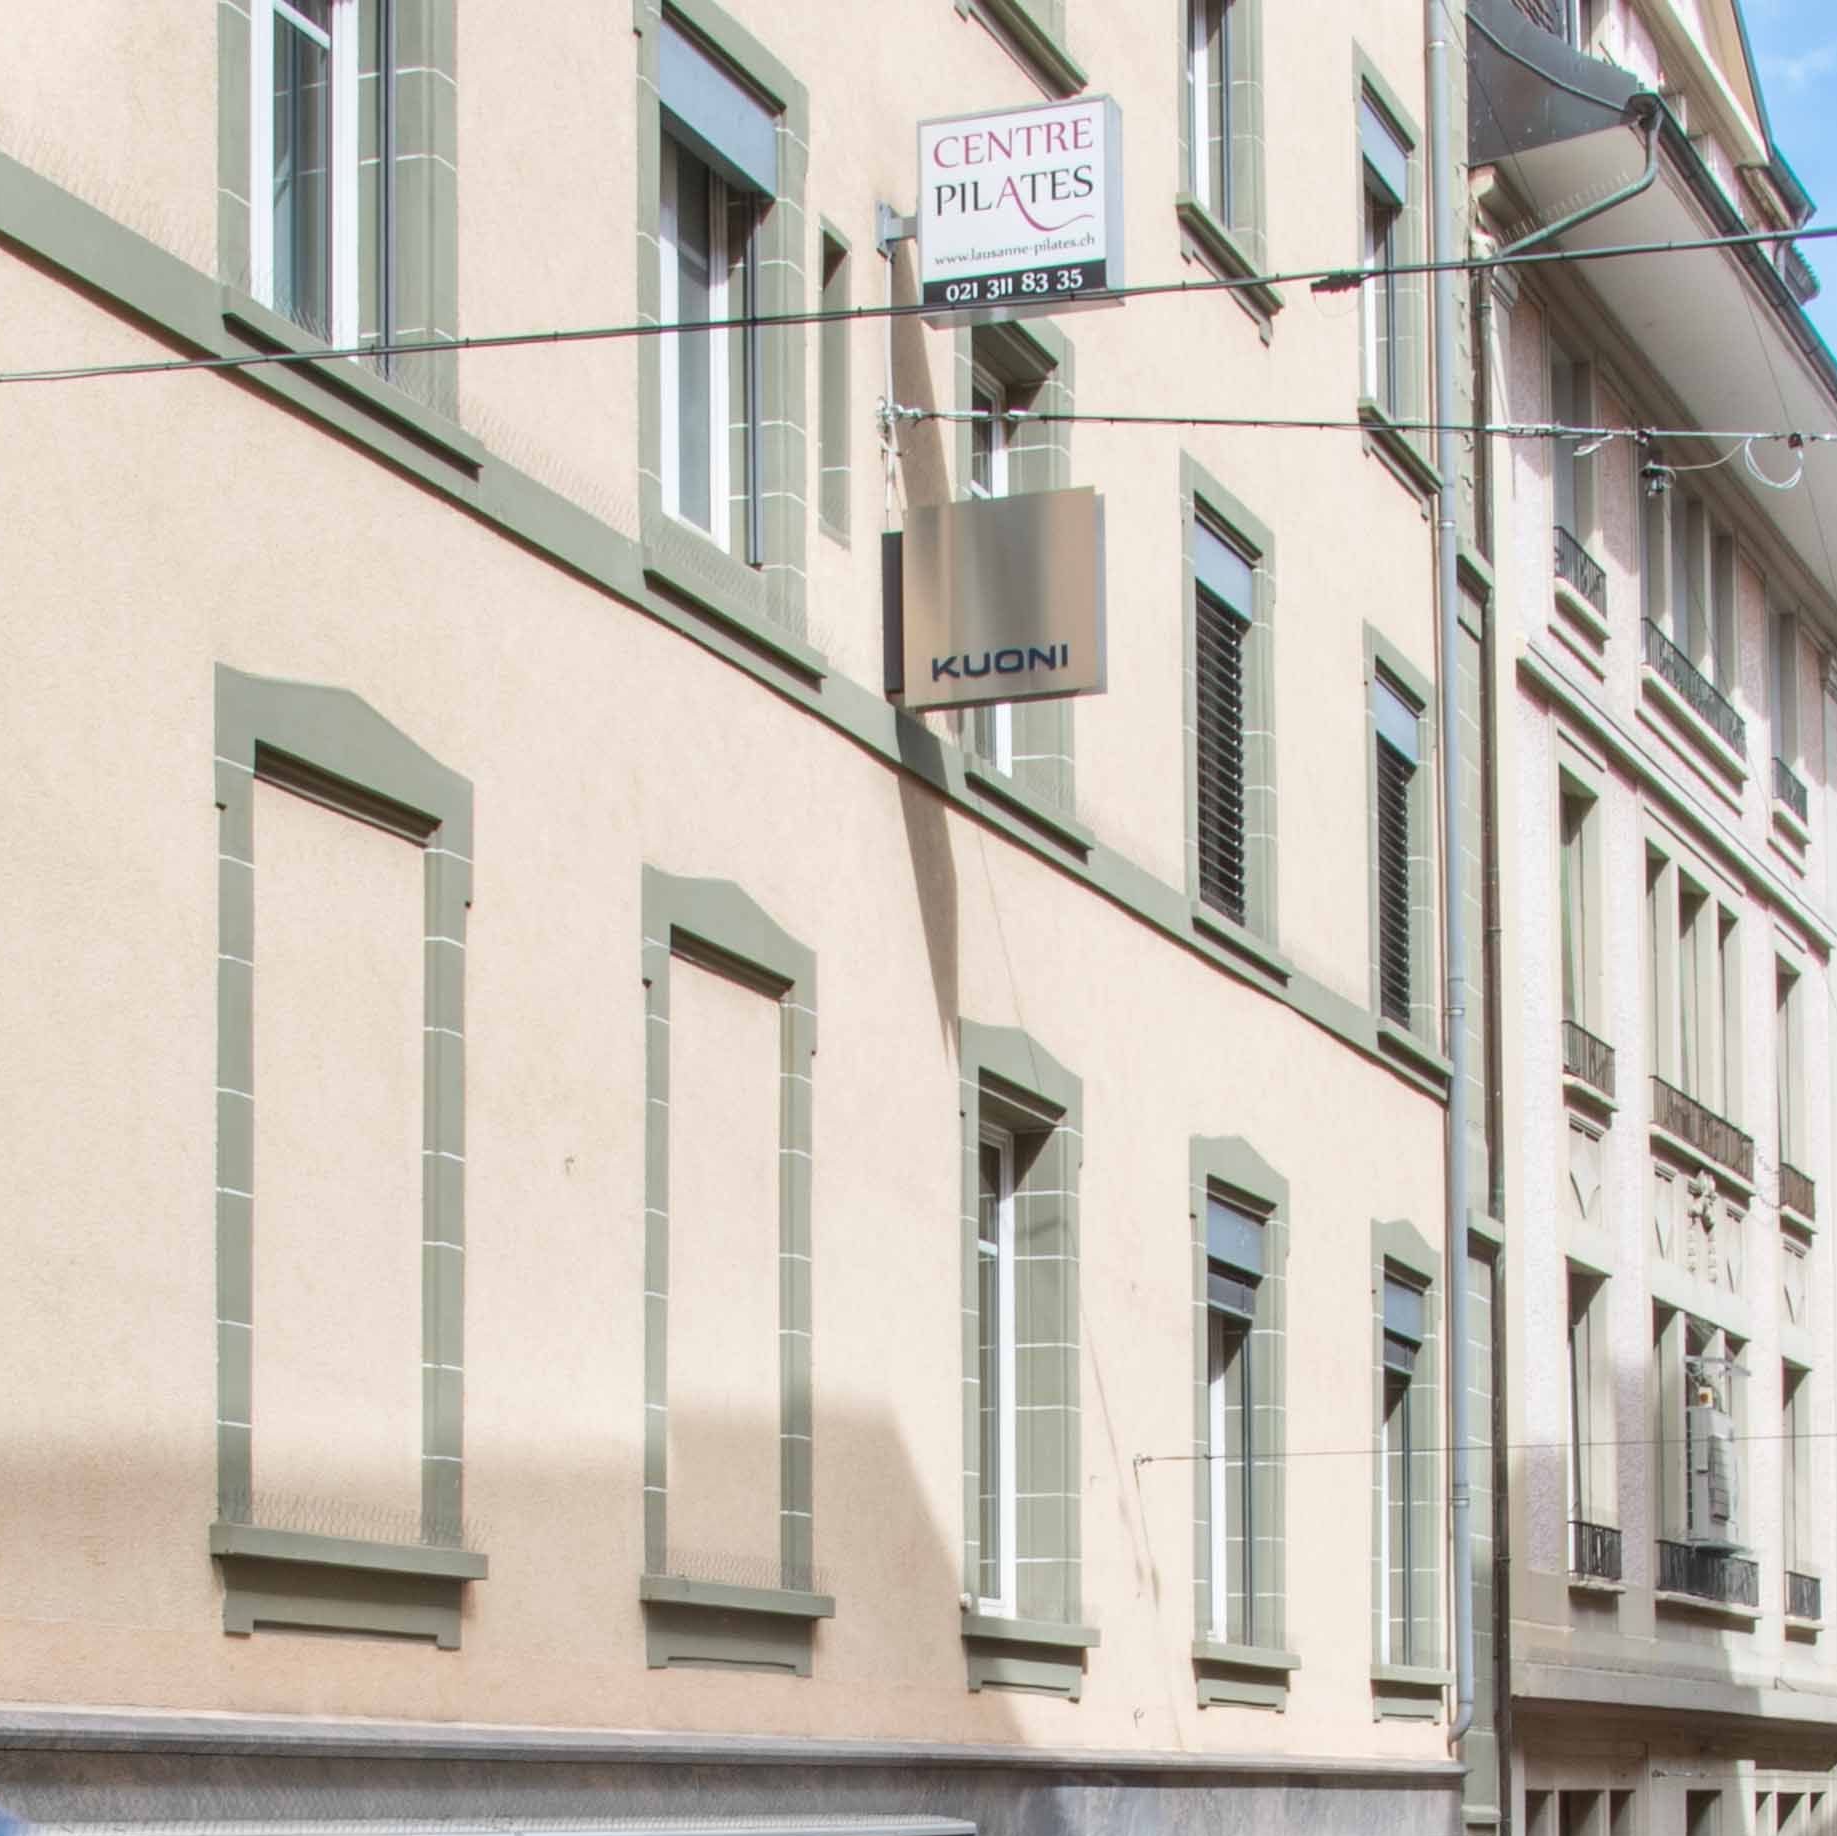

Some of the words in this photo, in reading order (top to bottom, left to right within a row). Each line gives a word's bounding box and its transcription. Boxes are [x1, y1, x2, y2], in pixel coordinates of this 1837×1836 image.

[932, 117, 1094, 169] CENTRE
[934, 164, 1094, 231] PILATES
[934, 232, 1096, 266] www.lausanne-pilates.ch
[945, 282, 978, 302] 021
[985, 274, 1013, 298] 311
[1021, 271, 1049, 294] 83
[1056, 268, 1083, 291] 35
[931, 643, 1068, 682] KUONI
